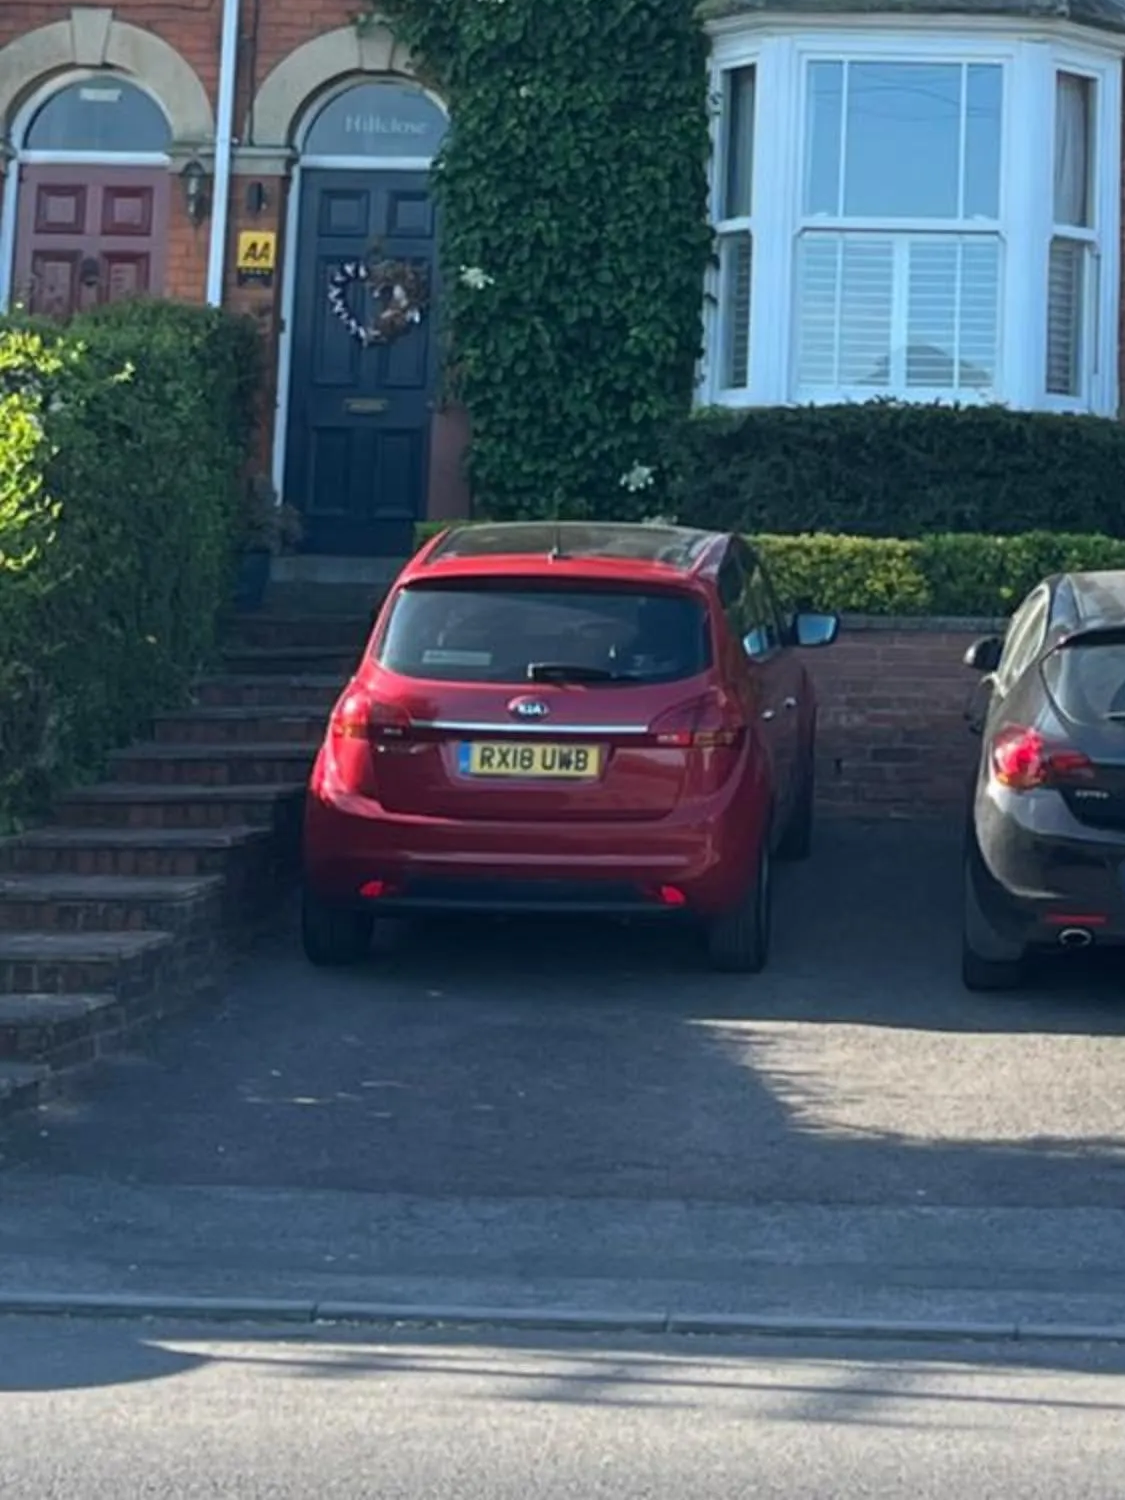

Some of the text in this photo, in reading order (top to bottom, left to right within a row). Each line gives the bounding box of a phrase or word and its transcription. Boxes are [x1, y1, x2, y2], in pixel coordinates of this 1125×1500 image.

[243, 241, 270, 261] AA
[480, 746, 589, 771] RX18 UWB
